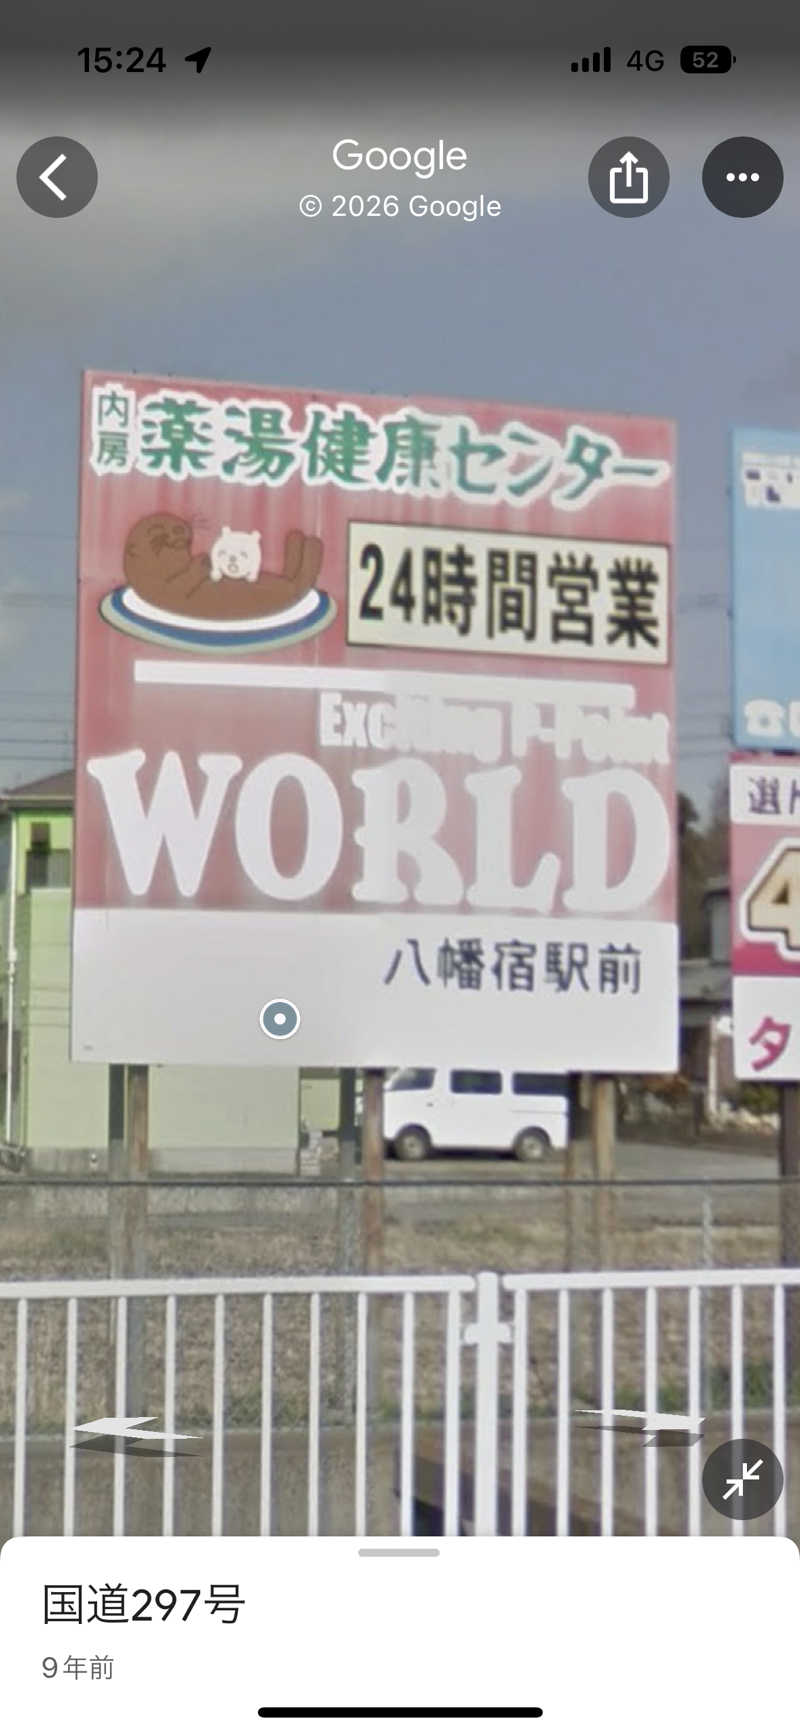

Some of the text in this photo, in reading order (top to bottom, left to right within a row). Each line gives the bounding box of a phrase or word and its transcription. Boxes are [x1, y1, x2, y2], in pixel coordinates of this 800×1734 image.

[97, 391, 130, 466] 内房
[139, 397, 664, 502] 薬湯健康センター
[358, 543, 661, 650] 24時間営業
[87, 747, 670, 915] WORLD
[384, 936, 642, 997] 八幡宿駅前
